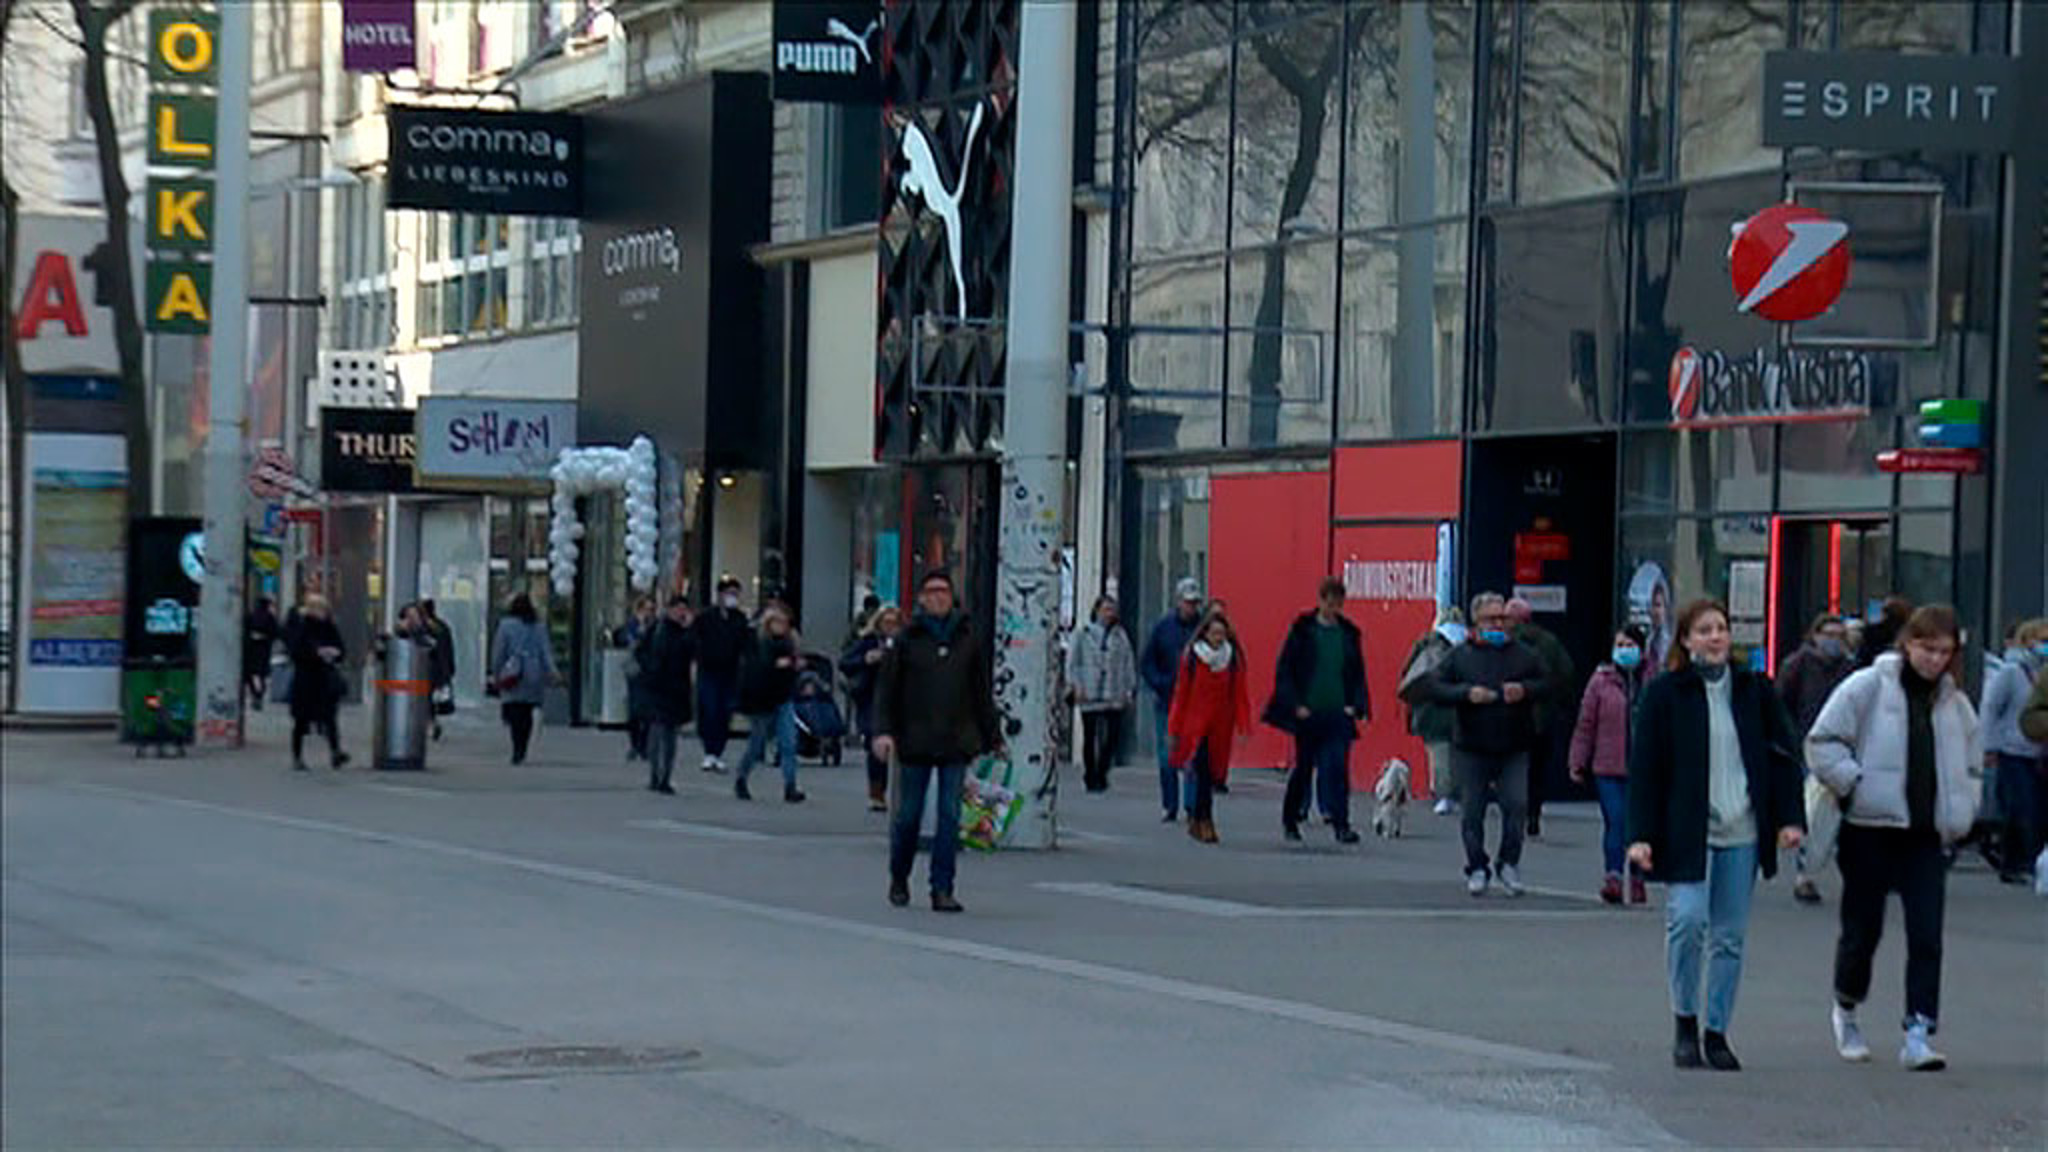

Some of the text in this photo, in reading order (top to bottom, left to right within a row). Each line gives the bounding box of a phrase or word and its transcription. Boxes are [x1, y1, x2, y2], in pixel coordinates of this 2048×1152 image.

[345, 23, 412, 45] HOTEL
[777, 42, 857, 75] PUMA
[1782, 81, 1998, 121] ESPRIT
[1702, 344, 1870, 416] Bank Austria
